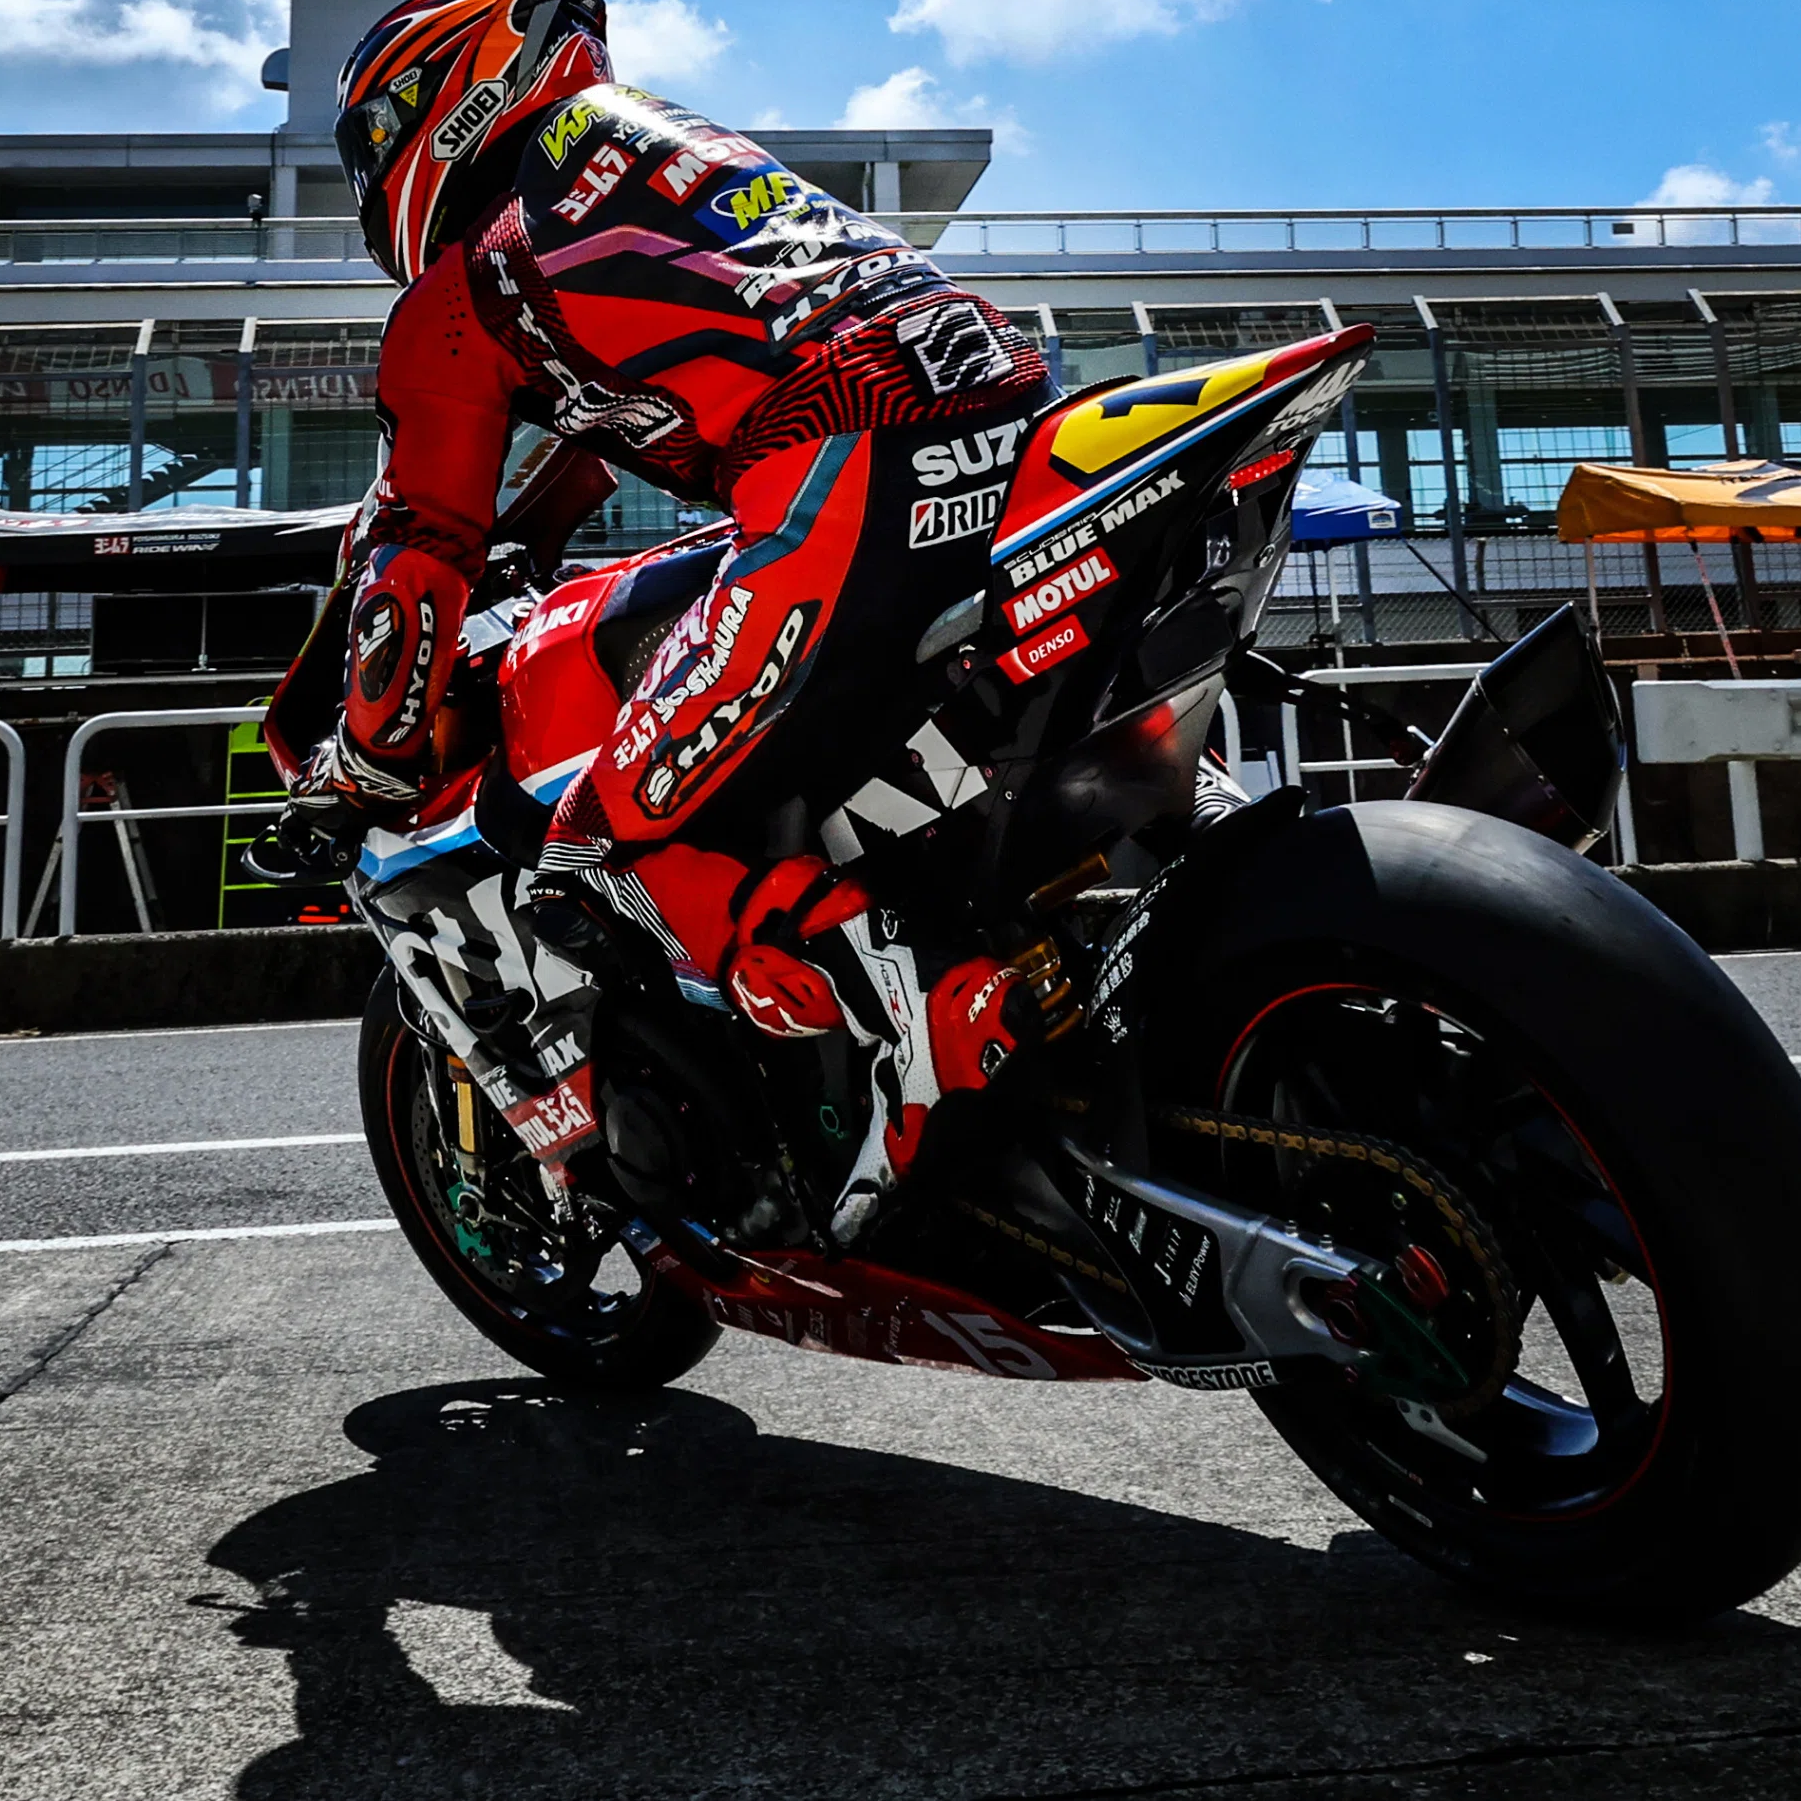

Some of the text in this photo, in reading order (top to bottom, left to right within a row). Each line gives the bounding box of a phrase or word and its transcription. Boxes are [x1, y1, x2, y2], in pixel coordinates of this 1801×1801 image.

[392, 70, 418, 90] SHOEI
[438, 86, 502, 154] SHOEI
[550, 141, 629, 223] ヨシムラ
[771, 250, 926, 341] HYOD
[911, 418, 1028, 487] SUZ
[131, 545, 171, 555] RIDE
[1009, 469, 1186, 589] BLUE MAX
[1012, 555, 1111, 630] MOTUL
[399, 601, 434, 724] HYOD
[1028, 628, 1075, 664] DENSO
[677, 608, 803, 769] HYOD
